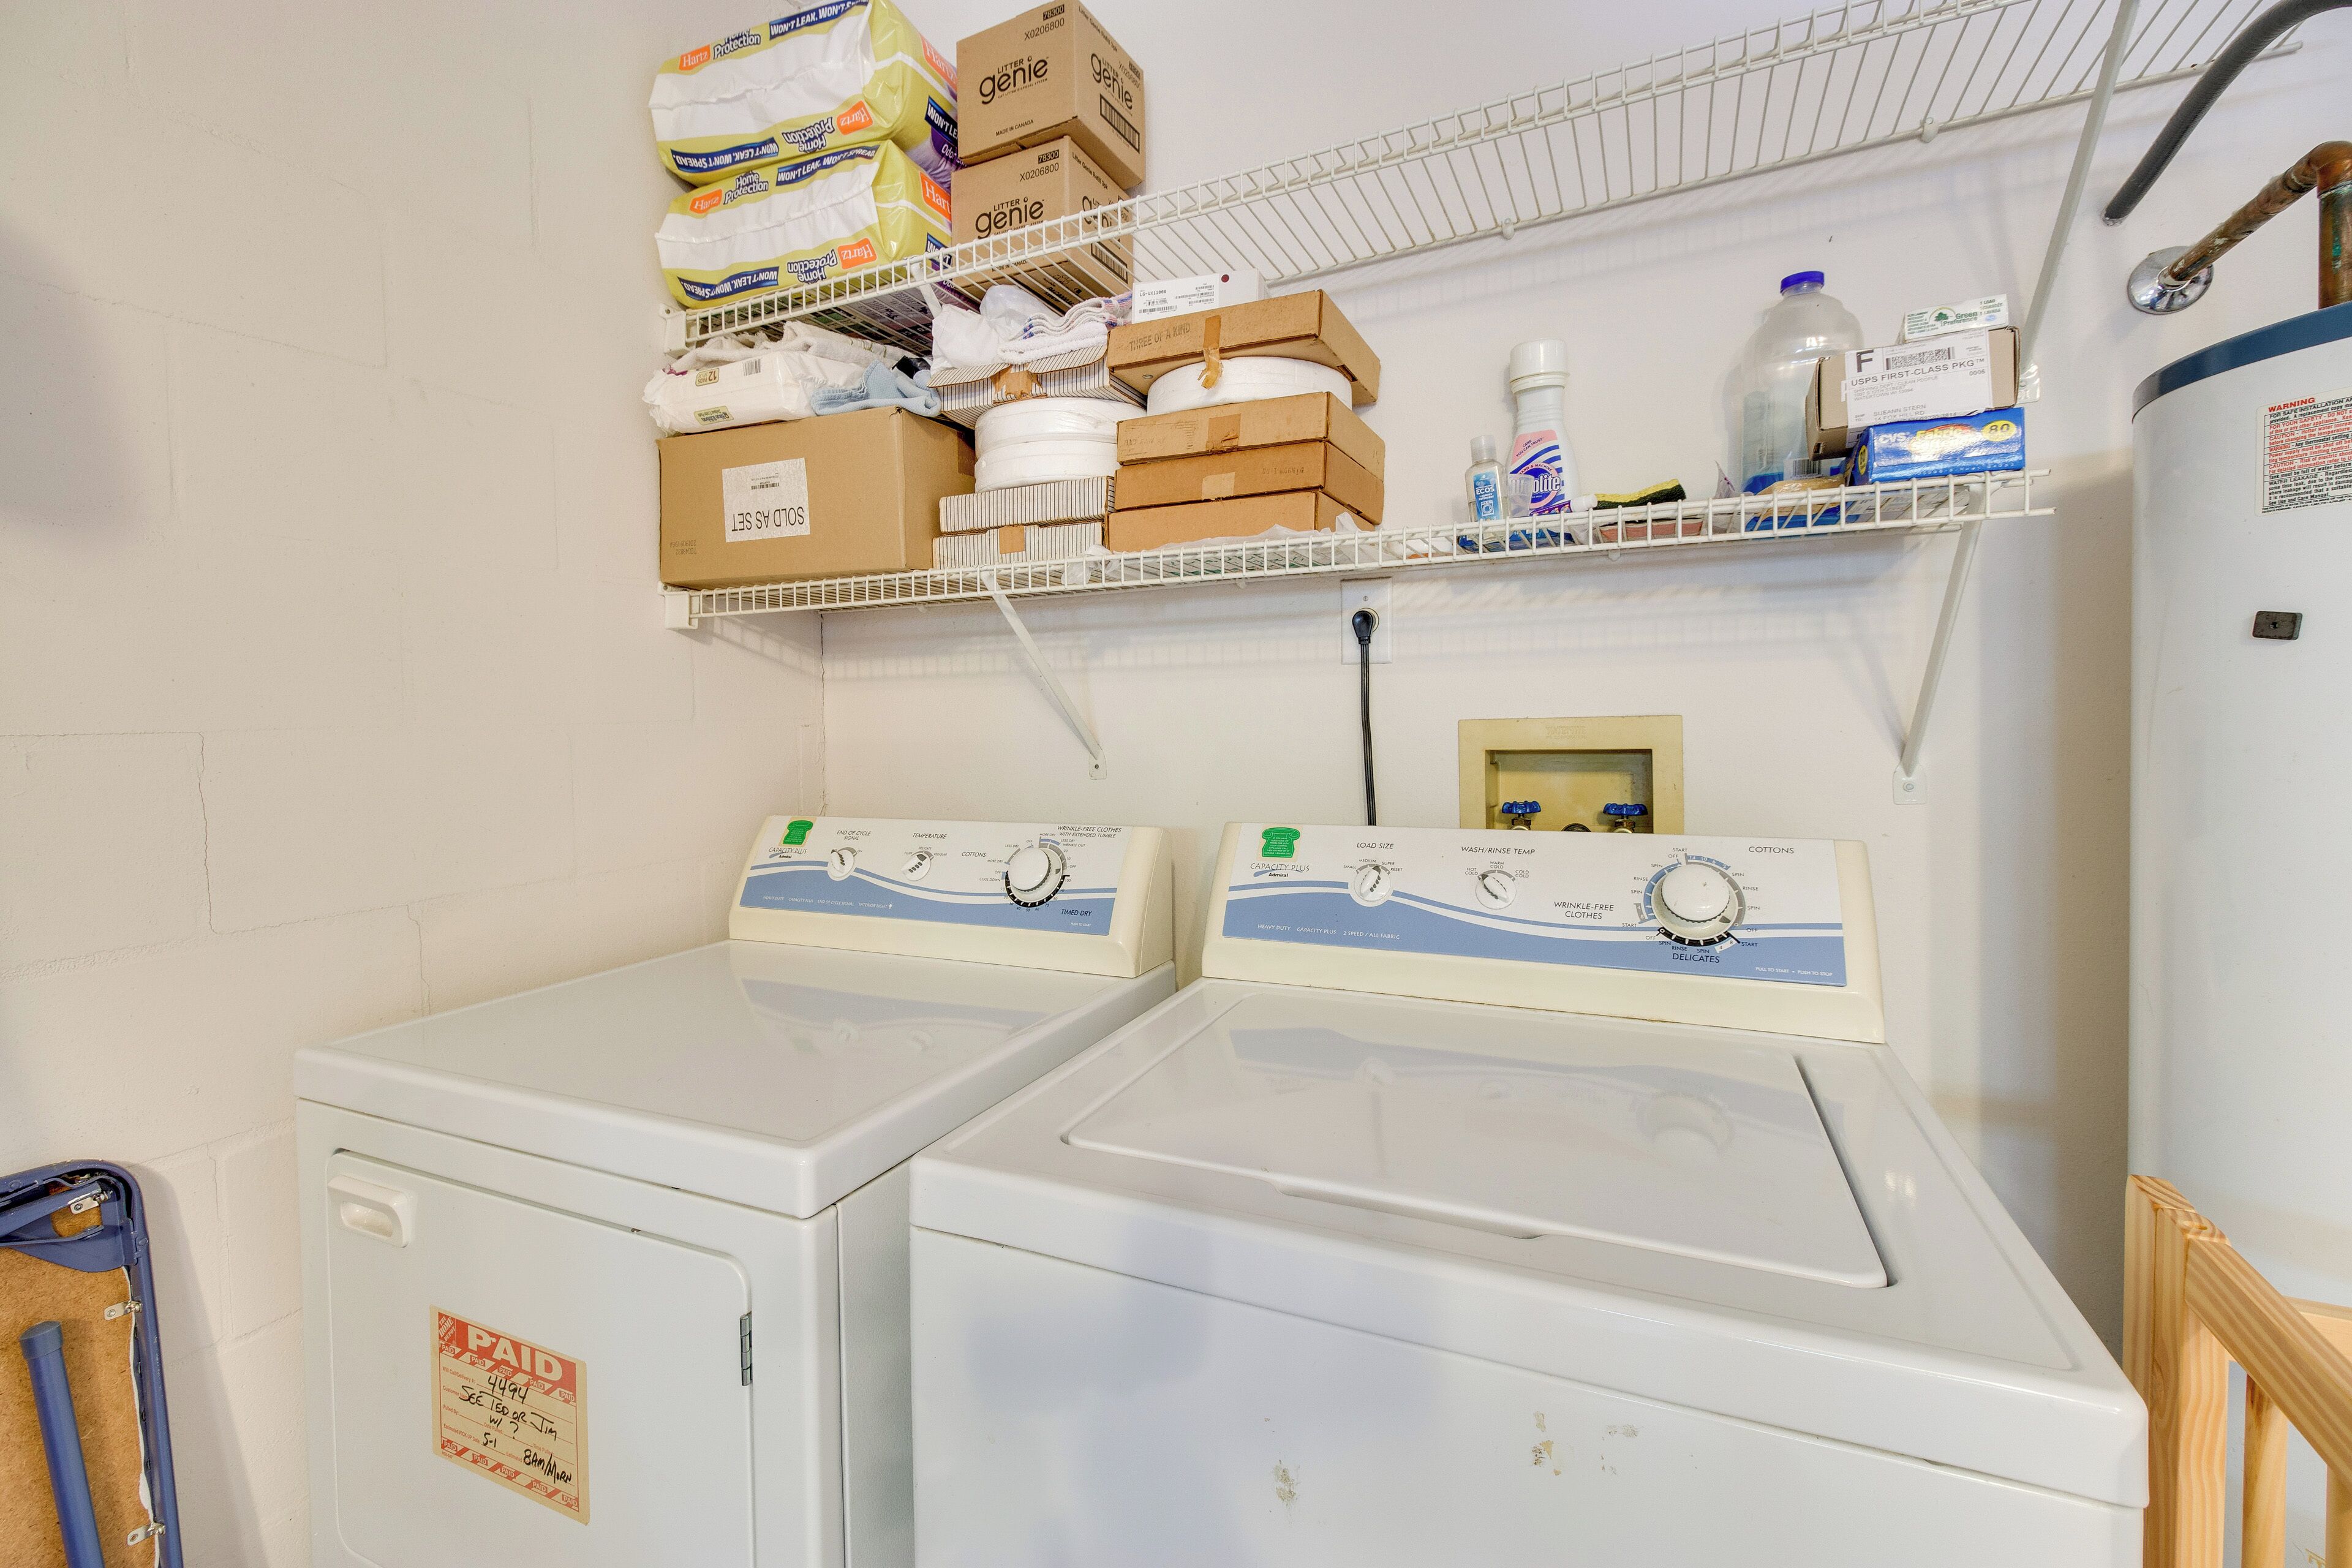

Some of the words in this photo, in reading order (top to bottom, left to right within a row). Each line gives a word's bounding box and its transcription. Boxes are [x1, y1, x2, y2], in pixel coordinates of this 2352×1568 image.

[1043, 5, 1064, 20] 78300
[771, 21, 795, 35] WON'T
[1024, 18, 1065, 40] X0206800
[713, 35, 760, 59] Protection
[683, 51, 707, 67] Hartz
[998, 59, 1023, 74] LITTER
[1102, 58, 1118, 78] LITTER
[980, 56, 1048, 104] genie
[1091, 53, 1133, 110] genie
[840, 107, 870, 126] Hartz
[782, 118, 834, 144] Protection
[996, 127, 1008, 137] MADE
[1014, 119, 1033, 130] CANADA
[757, 142, 778, 155] WON'T
[799, 135, 826, 152] Home
[708, 153, 732, 166] WON'T
[1038, 150, 1059, 163] 78300
[1072, 152, 1081, 165] Litter
[1082, 162, 1092, 176] Genie
[777, 168, 801, 182] WON'T
[823, 152, 847, 165] WON'T
[1020, 162, 1059, 182] X0206800
[736, 172, 760, 189] Home
[723, 182, 769, 205] Protection
[924, 180, 951, 214] Hart
[693, 196, 719, 210] Hartz
[993, 199, 1019, 211] LITTER
[975, 197, 1043, 239] genie
[788, 249, 838, 273] Protection
[842, 244, 873, 261] Hartz
[797, 268, 826, 282] Home
[1129, 334, 1152, 352] THREE
[1154, 332, 1163, 342] OF
[1166, 328, 1171, 340] A
[1172, 322, 1191, 337] KIND
[1856, 349, 1874, 372] F
[708, 371, 717, 381] 12
[1852, 376, 1877, 386] USPS
[1882, 364, 1948, 381] FIRST-CLASS
[2269, 398, 2315, 412] WARNING
[2299, 400, 2343, 412] INSTALLATION
[1989, 423, 2010, 433] 80
[732, 512, 752, 532] SET
[756, 510, 769, 529] AS
[774, 507, 804, 527] SOLD
[1554, 902, 1614, 911] WRINKLE-FREE
[1672, 952, 1720, 963] DELICATES
[439, 1317, 454, 1337] HOME
[444, 1325, 456, 1341] DEPOT
[442, 1344, 454, 1354] PAID
[467, 1324, 562, 1381] PAID
[471, 1355, 484, 1365] PAID
[499, 1368, 512, 1376] PAID
[488, 1375, 529, 1404] 4494
[530, 1379, 543, 1389] PAID
[459, 1385, 484, 1406] SEE
[480, 1391, 509, 1415] TED
[512, 1411, 527, 1423] OR
[561, 1392, 575, 1401] PAID
[443, 1442, 456, 1451] PAID
[473, 1455, 486, 1464] PAID
[501, 1467, 514, 1477] PAID
[532, 1481, 546, 1492] PAID
[564, 1495, 578, 1506] PAID
